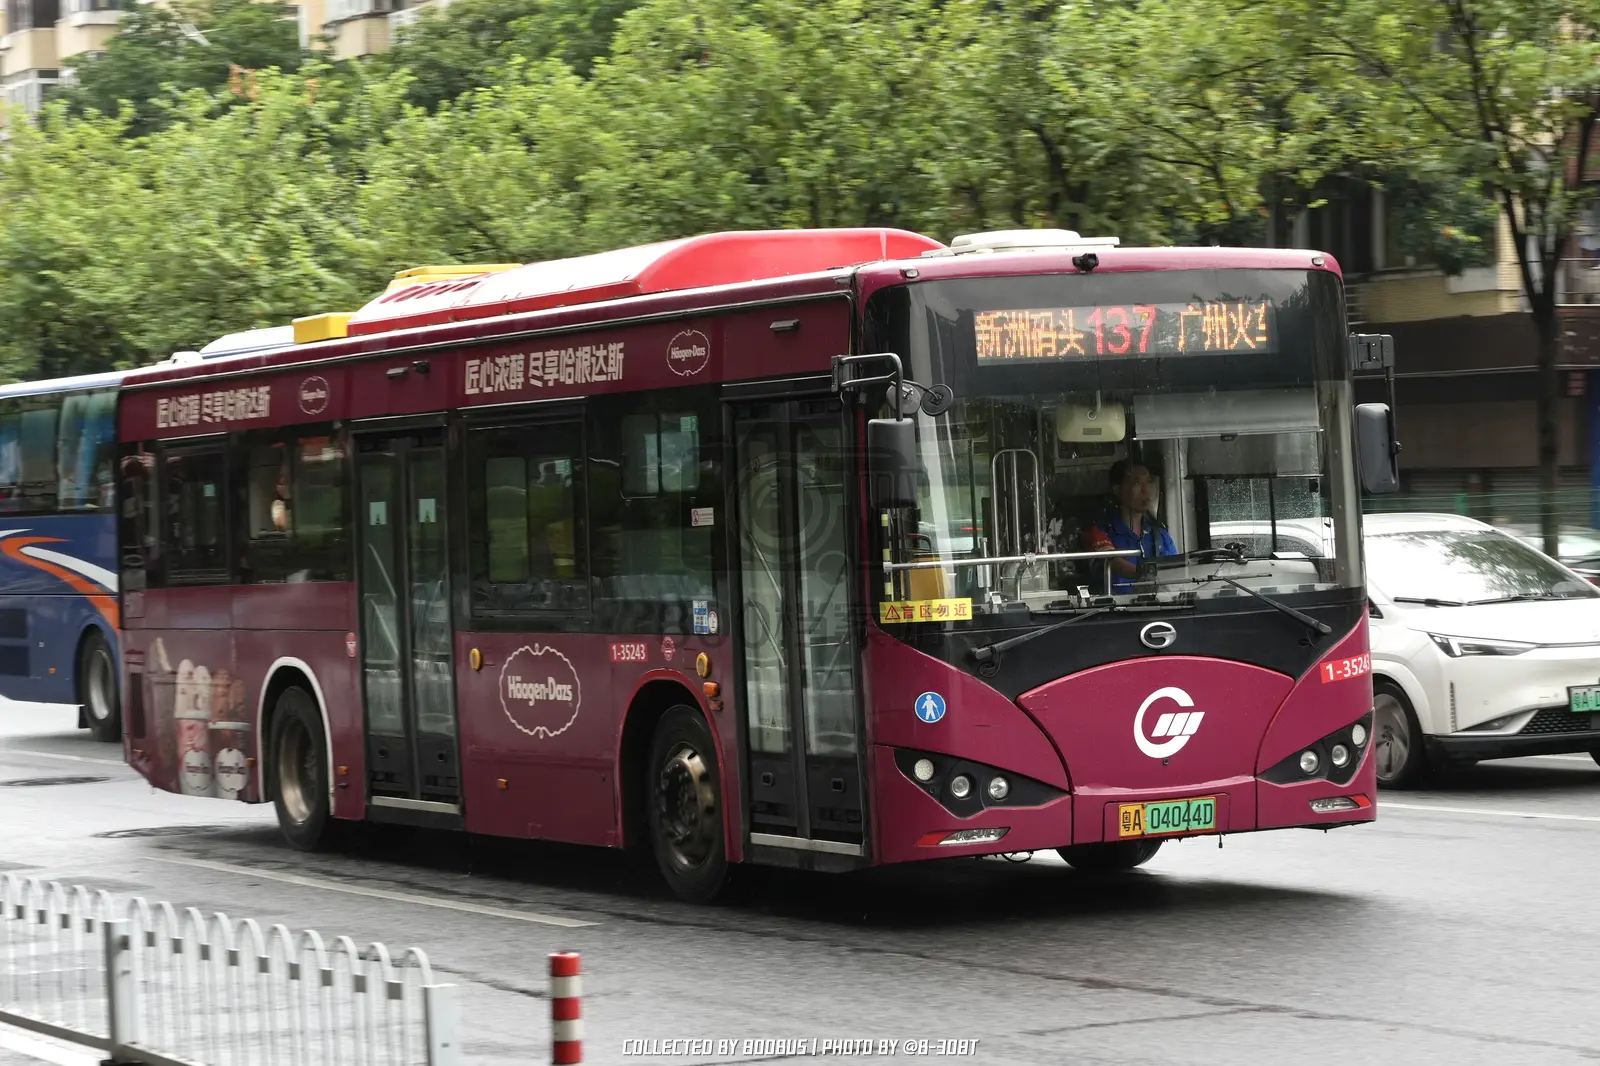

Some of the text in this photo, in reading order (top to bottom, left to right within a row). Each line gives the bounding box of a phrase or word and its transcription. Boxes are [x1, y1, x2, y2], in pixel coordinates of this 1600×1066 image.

[1088, 304, 1157, 355] 137
[464, 342, 625, 395] 匠心浓醇 尽享哈根达斯
[901, 603, 968, 619] 盲区勿近
[612, 643, 646, 661] 1-35243
[1325, 653, 1370, 681] 1-35243
[507, 675, 573, 707] Häagen-Dazs
